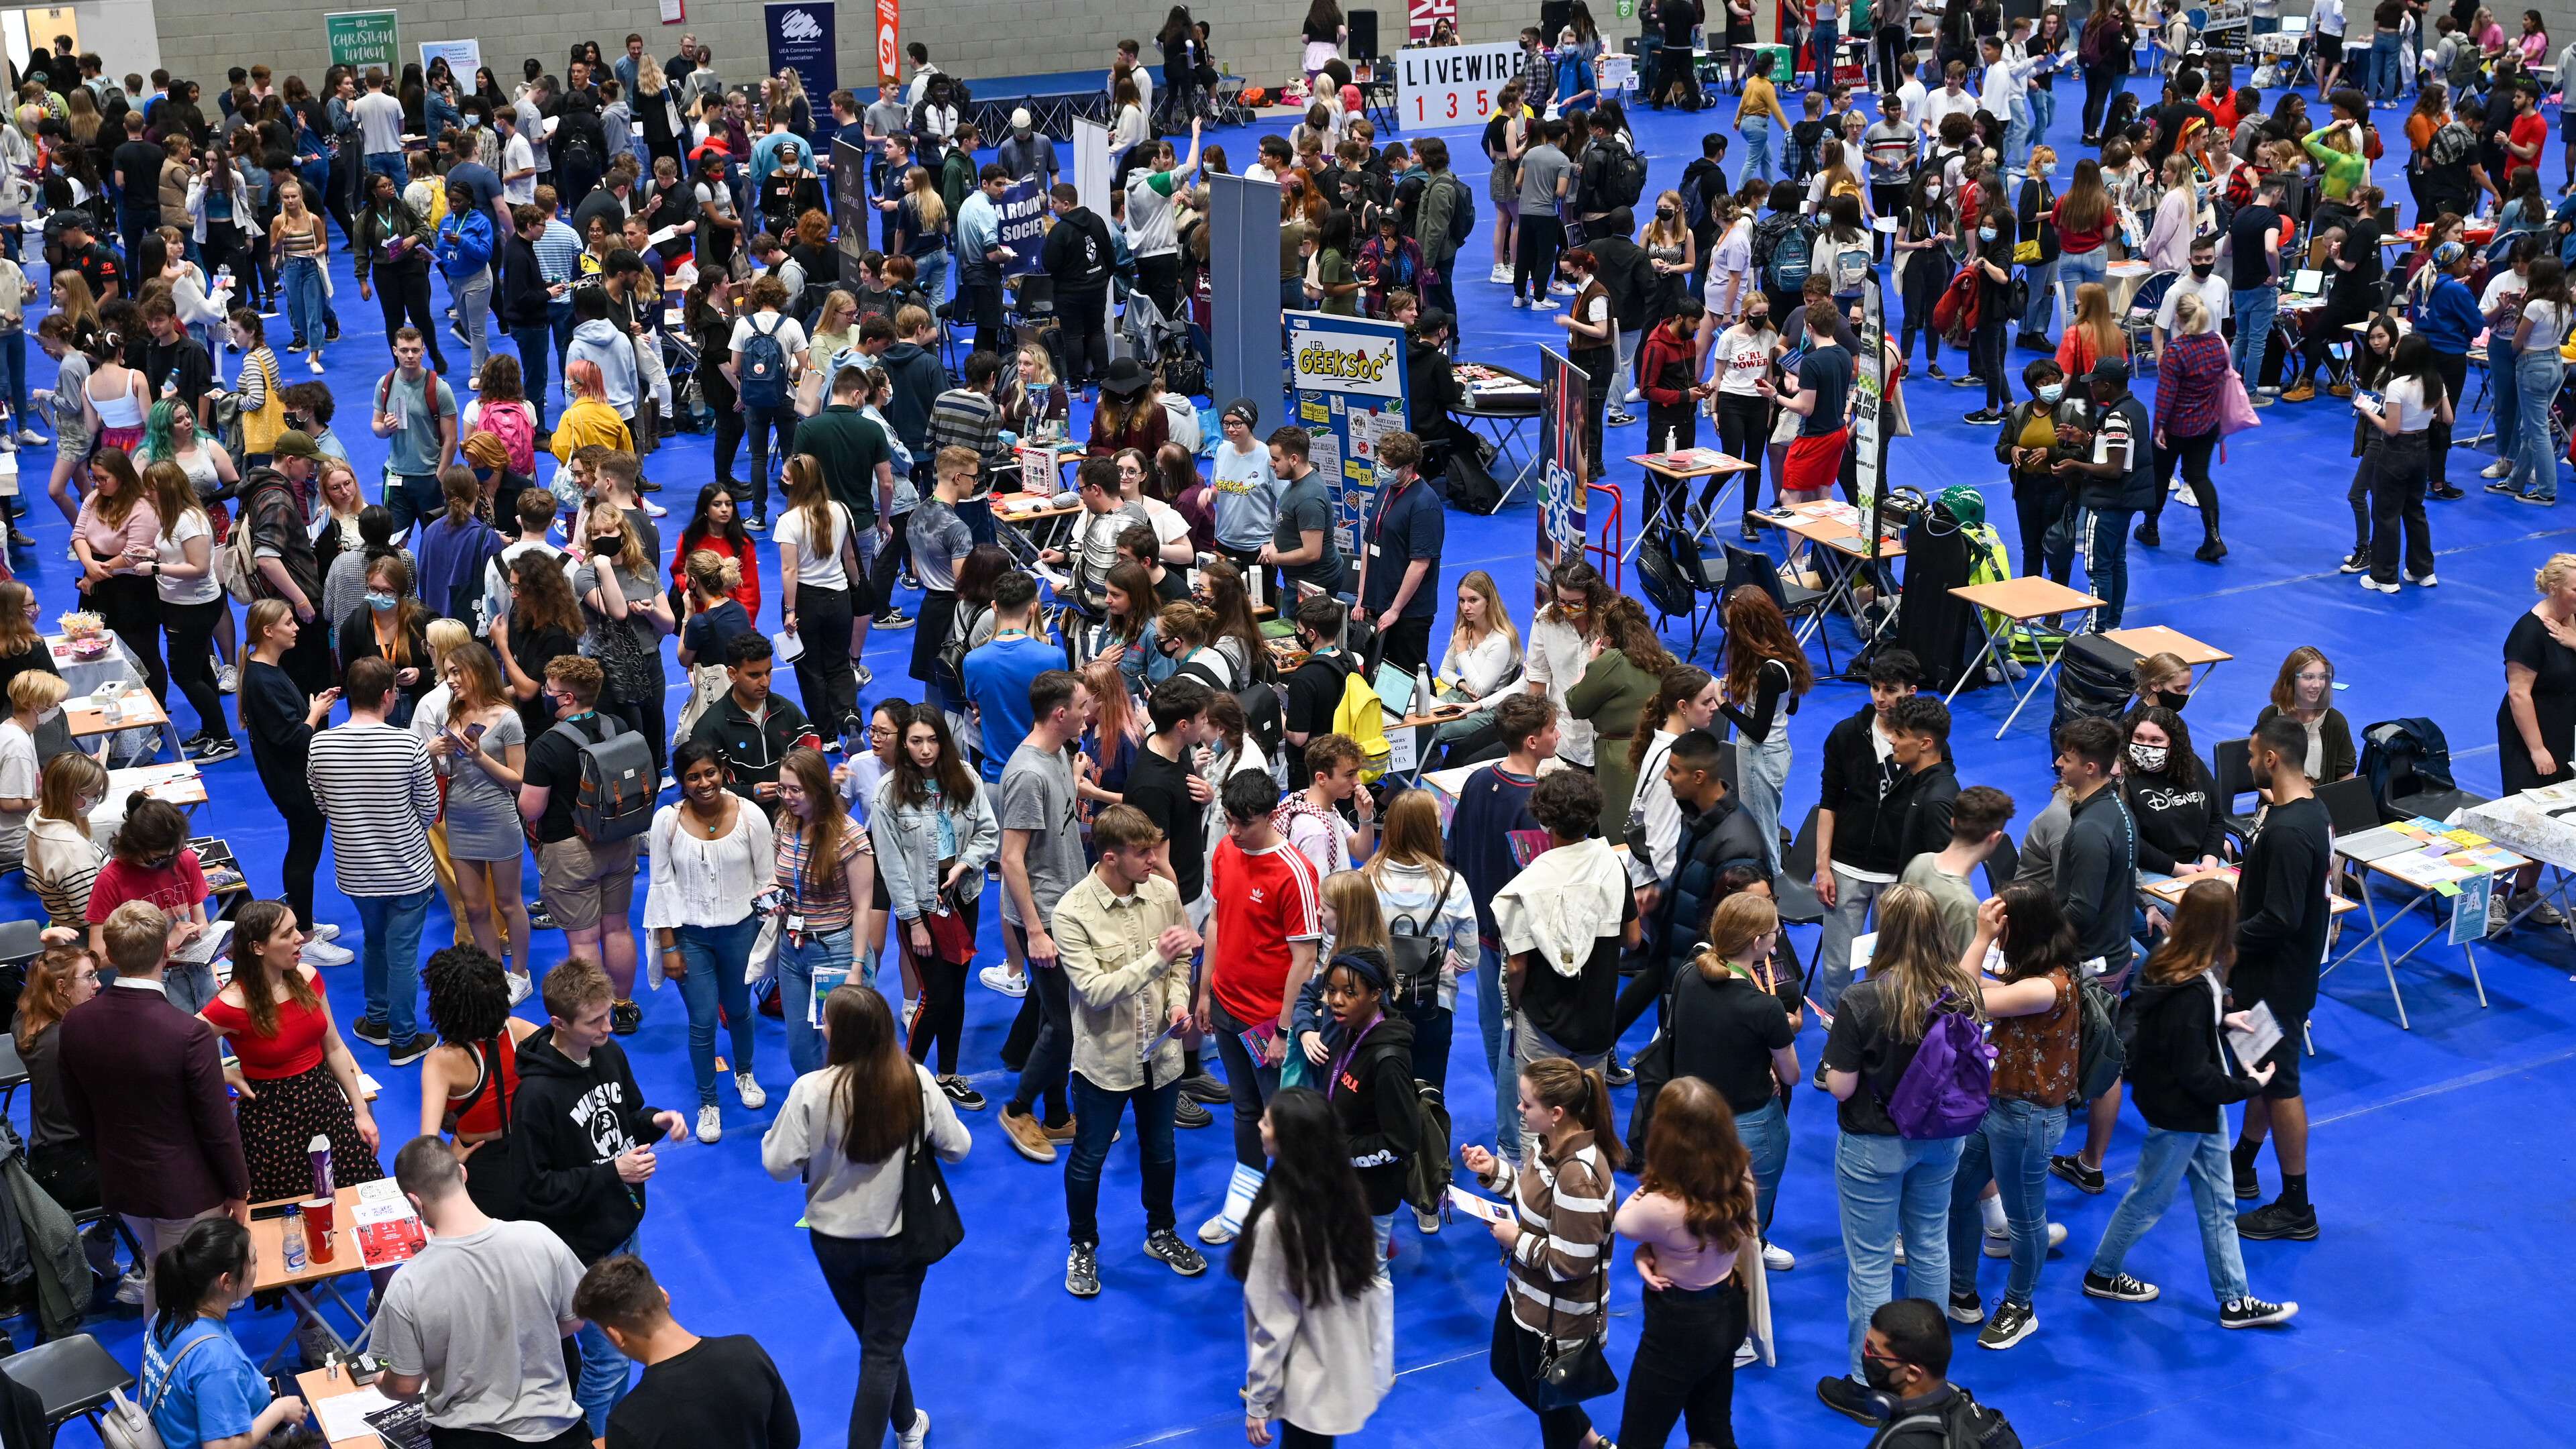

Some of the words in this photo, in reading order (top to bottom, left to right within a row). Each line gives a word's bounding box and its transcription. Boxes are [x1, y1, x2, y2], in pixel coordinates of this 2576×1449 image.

[356, 19, 368, 28] UEA
[333, 30, 394, 46] CHRISTIAN
[344, 45, 386, 61] UNION
[1407, 52, 1523, 86] LIVEWIRE
[582, 259, 590, 268] 2
[1310, 341, 1325, 350] UEA
[1299, 348, 1384, 382] GEEKSOC
[1733, 358, 1768, 369] POWER
[1249, 895, 1262, 904] adidas
[1341, 1071, 1360, 1094] SOUL
[570, 1081, 623, 1128] MUSIC
